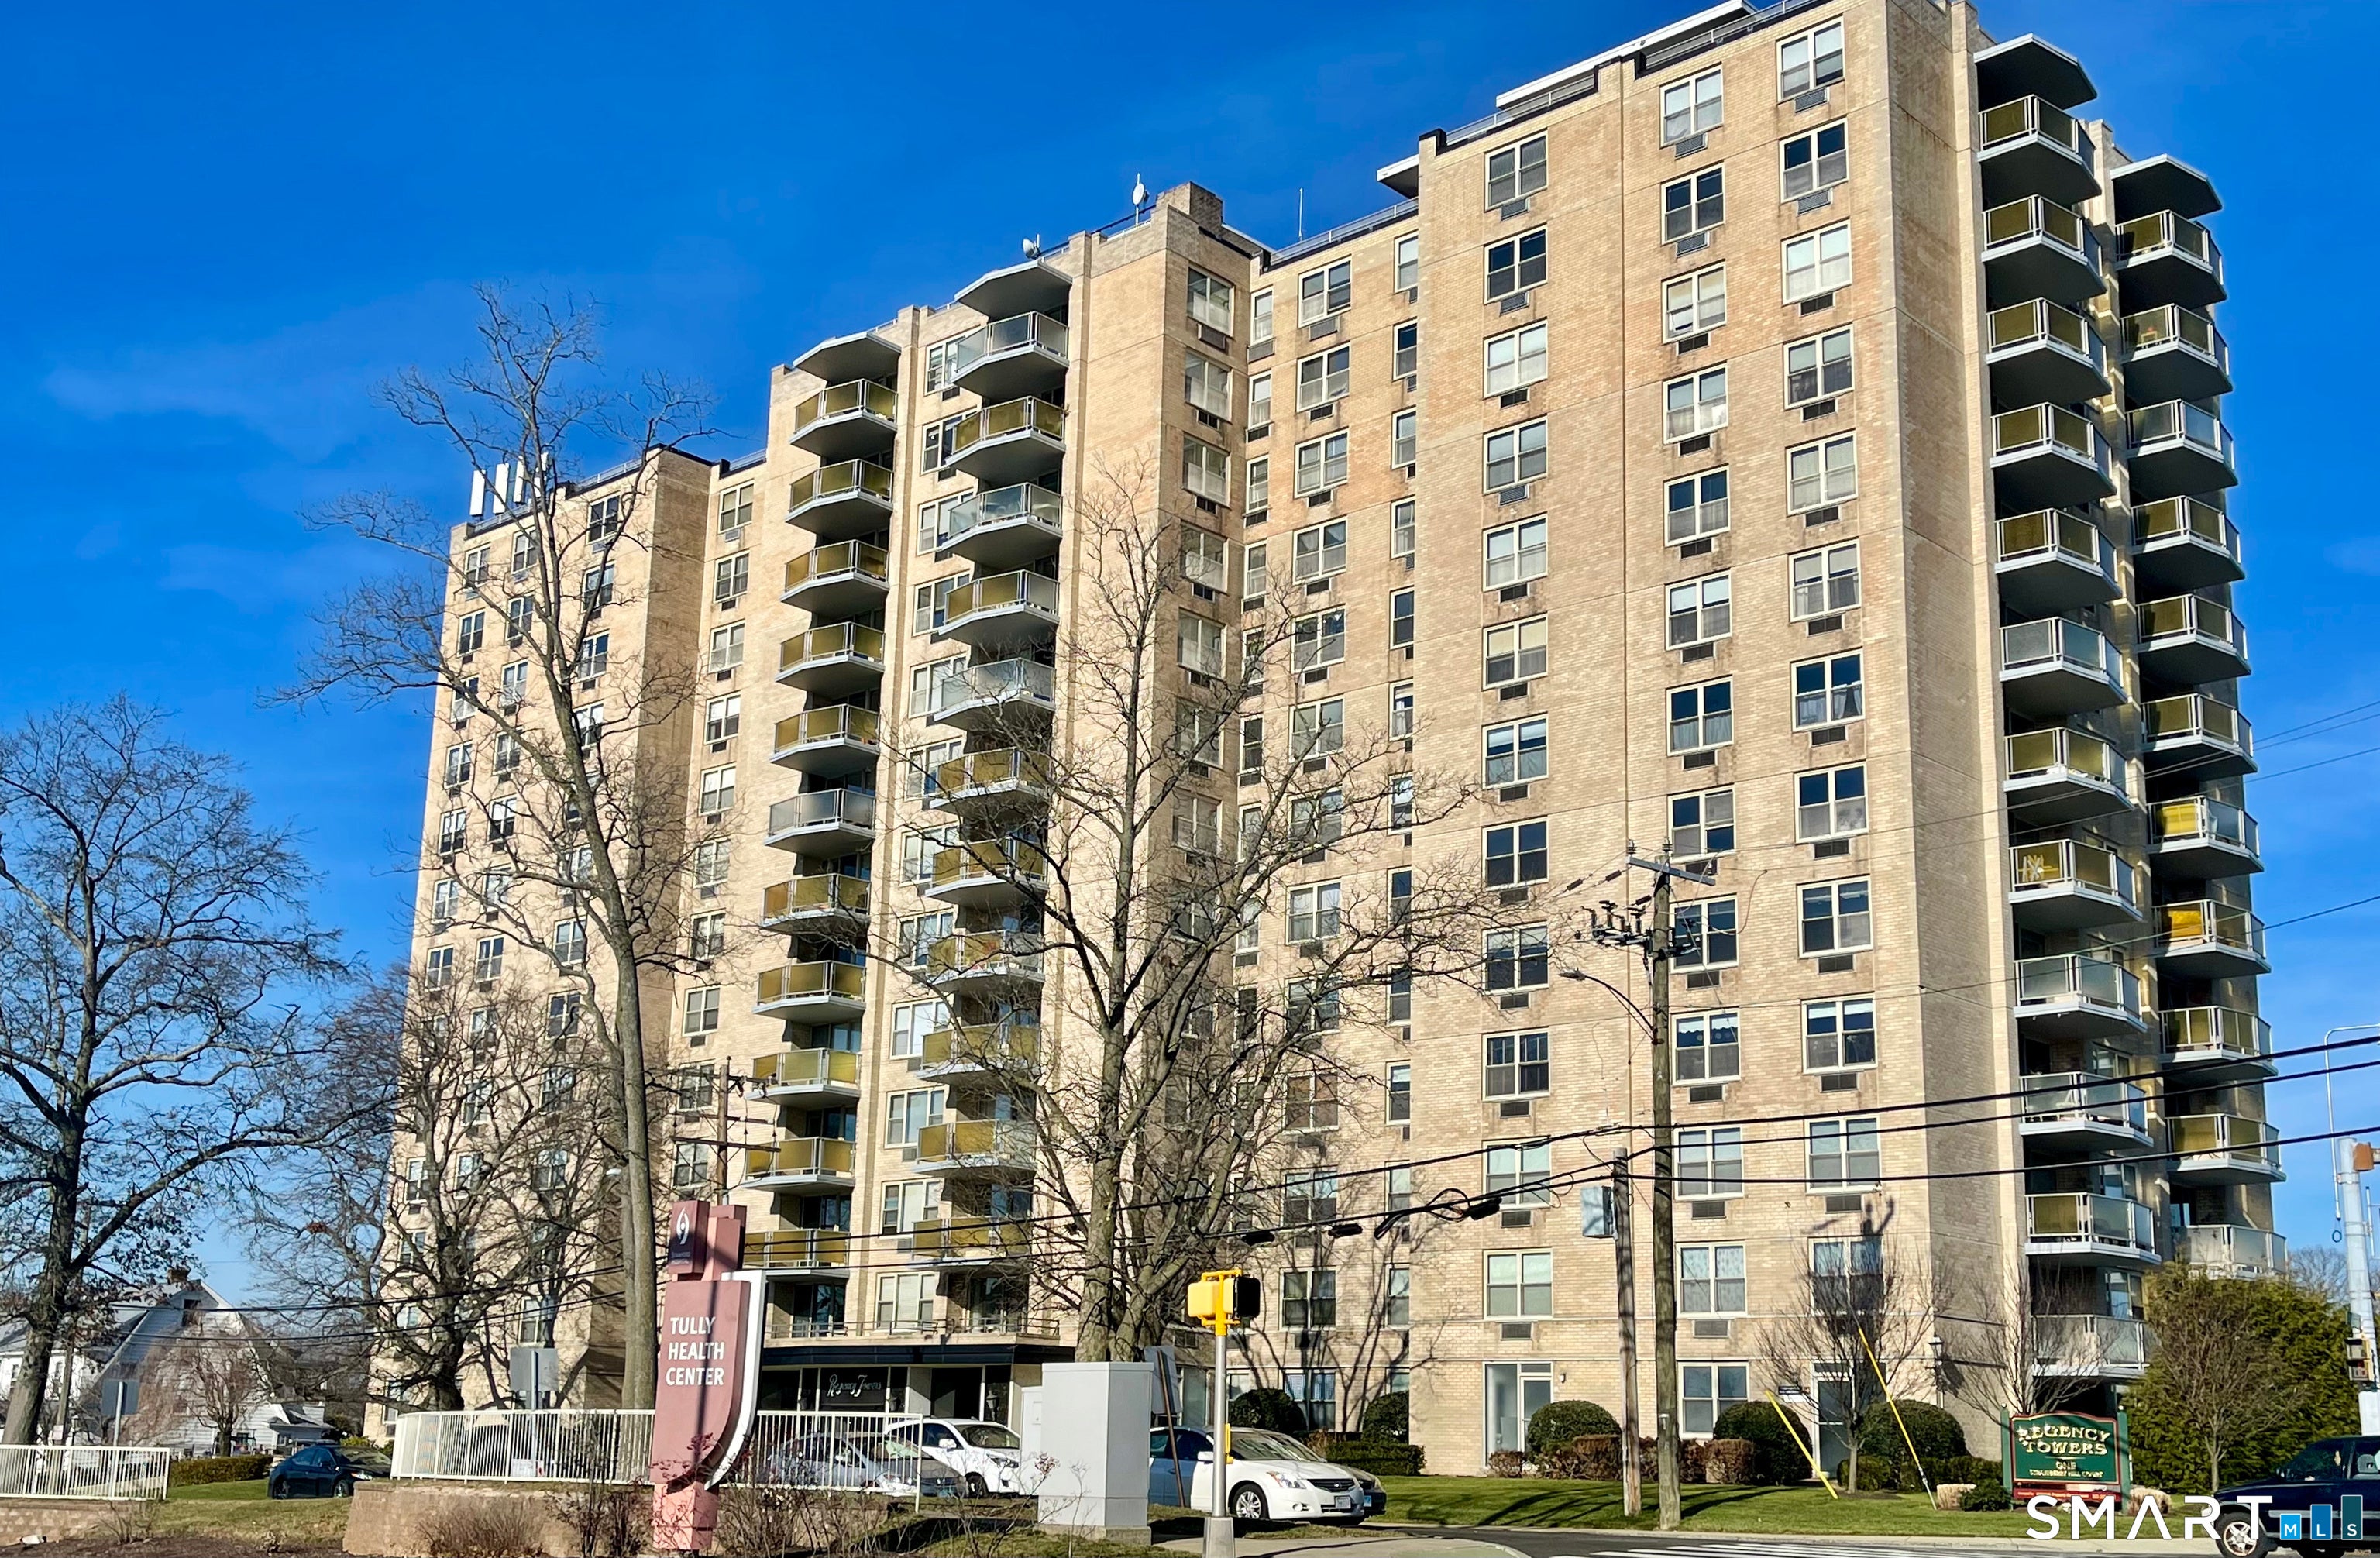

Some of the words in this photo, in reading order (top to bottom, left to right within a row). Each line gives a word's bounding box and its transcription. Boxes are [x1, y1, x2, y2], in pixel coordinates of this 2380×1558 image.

[670, 1316, 716, 1335] TULLY
[668, 1342, 725, 1360] HEALTH
[666, 1367, 724, 1386] CENTER
[2017, 1423, 2110, 1443] REGENCY
[2021, 1439, 2107, 1455] TOWERS
